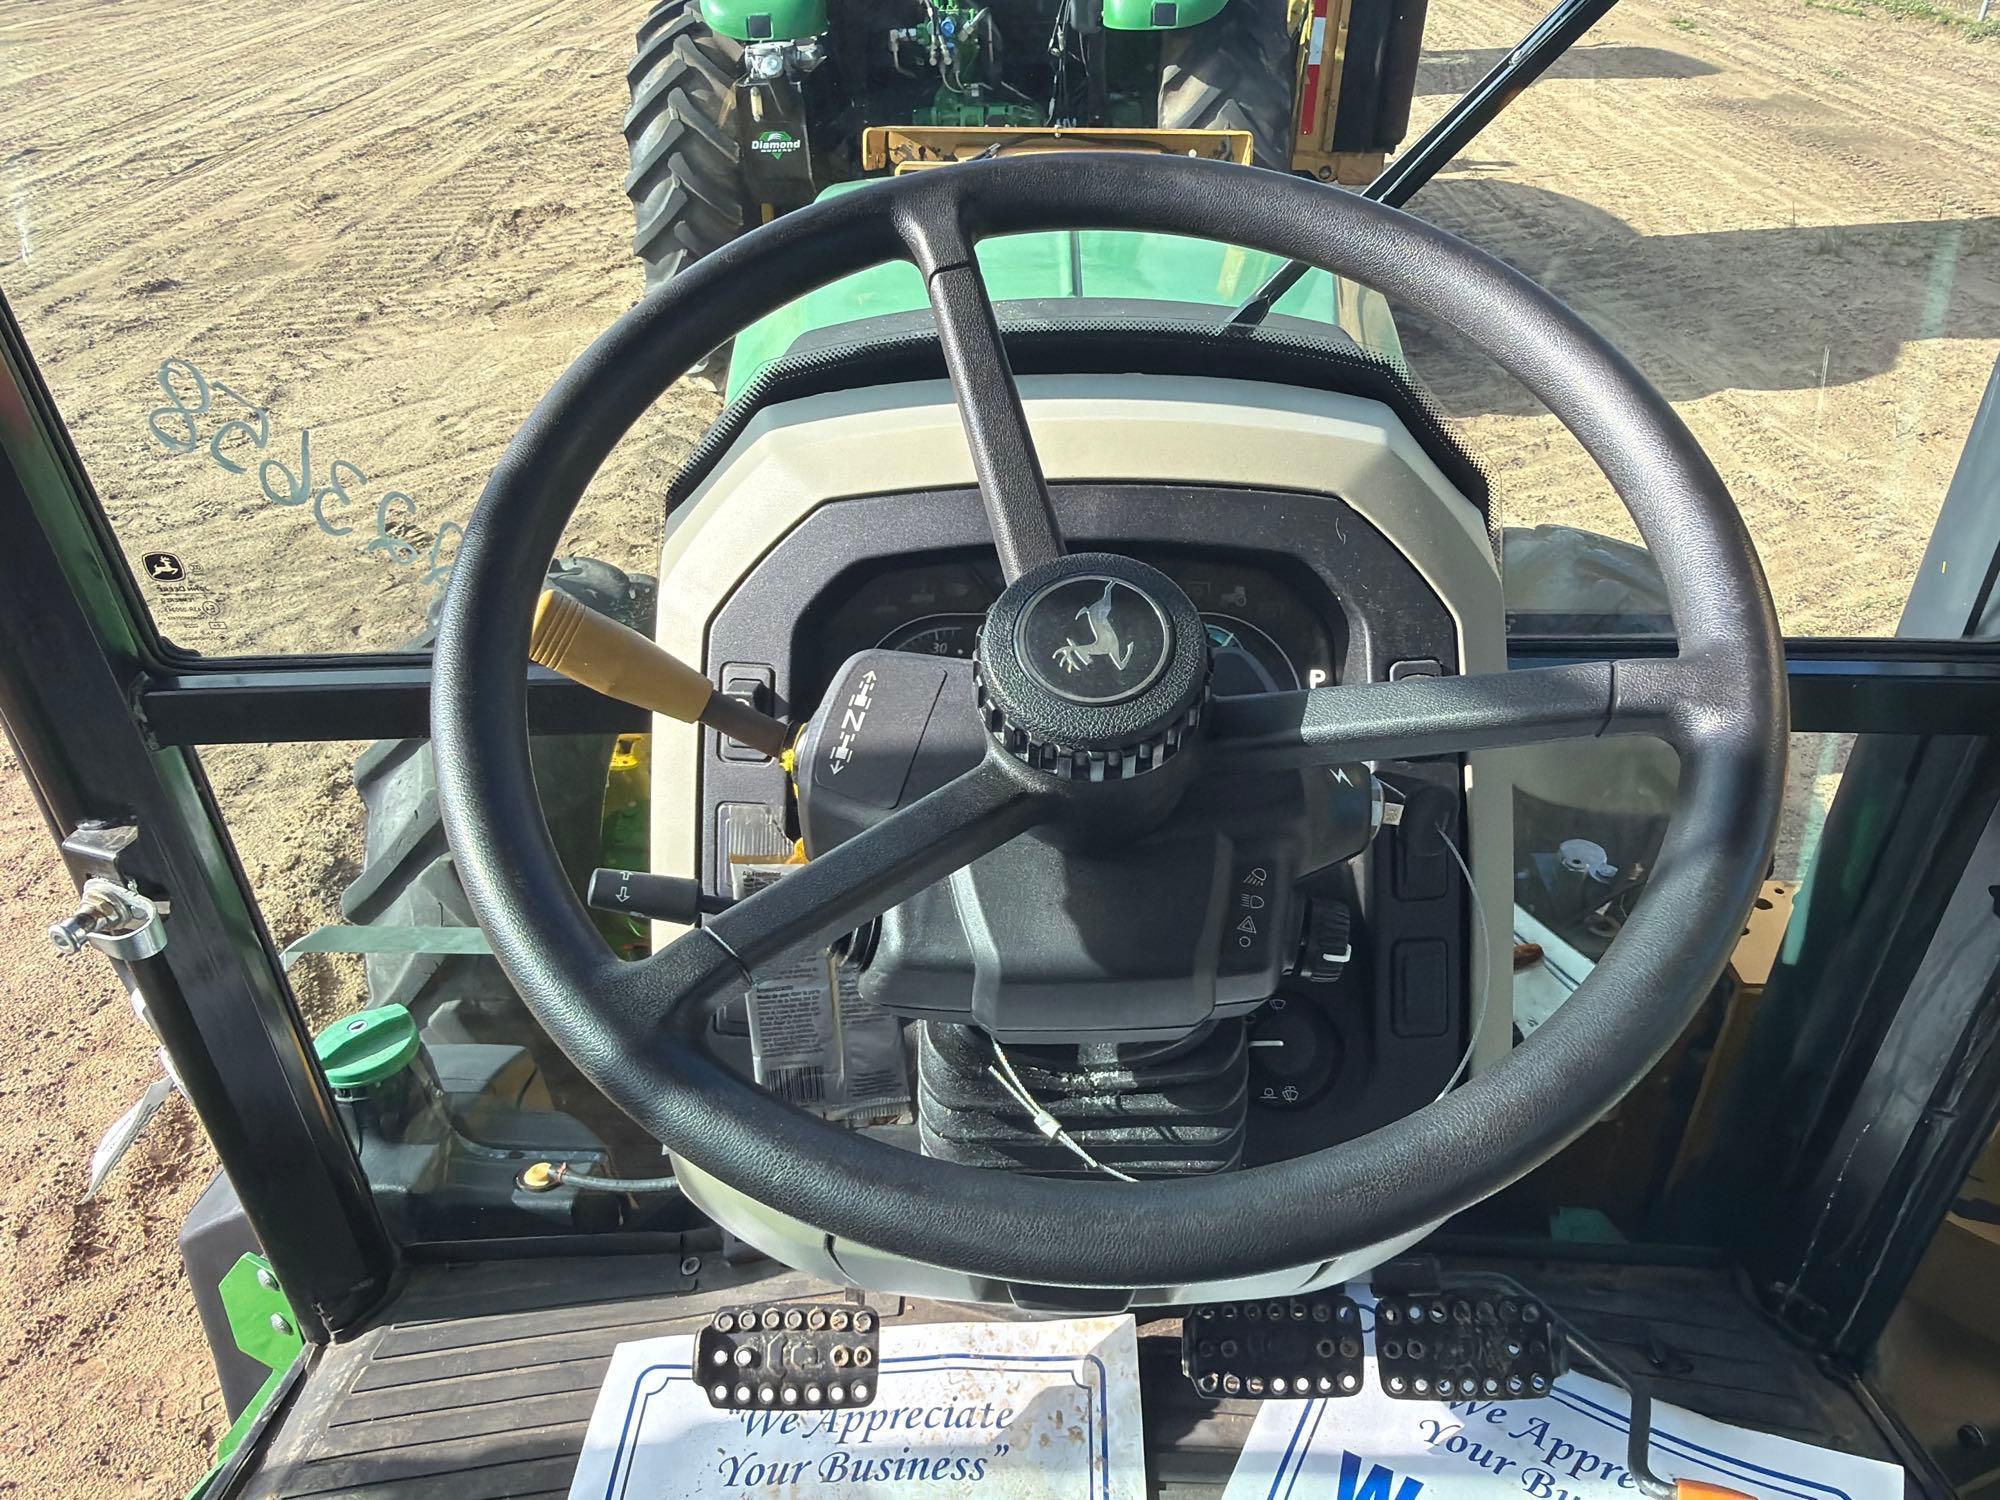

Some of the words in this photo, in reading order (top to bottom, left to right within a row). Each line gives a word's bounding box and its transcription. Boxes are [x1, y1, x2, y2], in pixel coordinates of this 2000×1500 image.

[751, 140, 801, 150] Diamond
[932, 642, 948, 654] 30
[1309, 669, 1327, 689] P
[841, 708, 866, 732] N
[802, 1396, 1015, 1445] Appreciate
[1419, 1419, 1517, 1476] Your
[1508, 1416, 1643, 1494] Appre
[718, 1451, 812, 1488] Your
